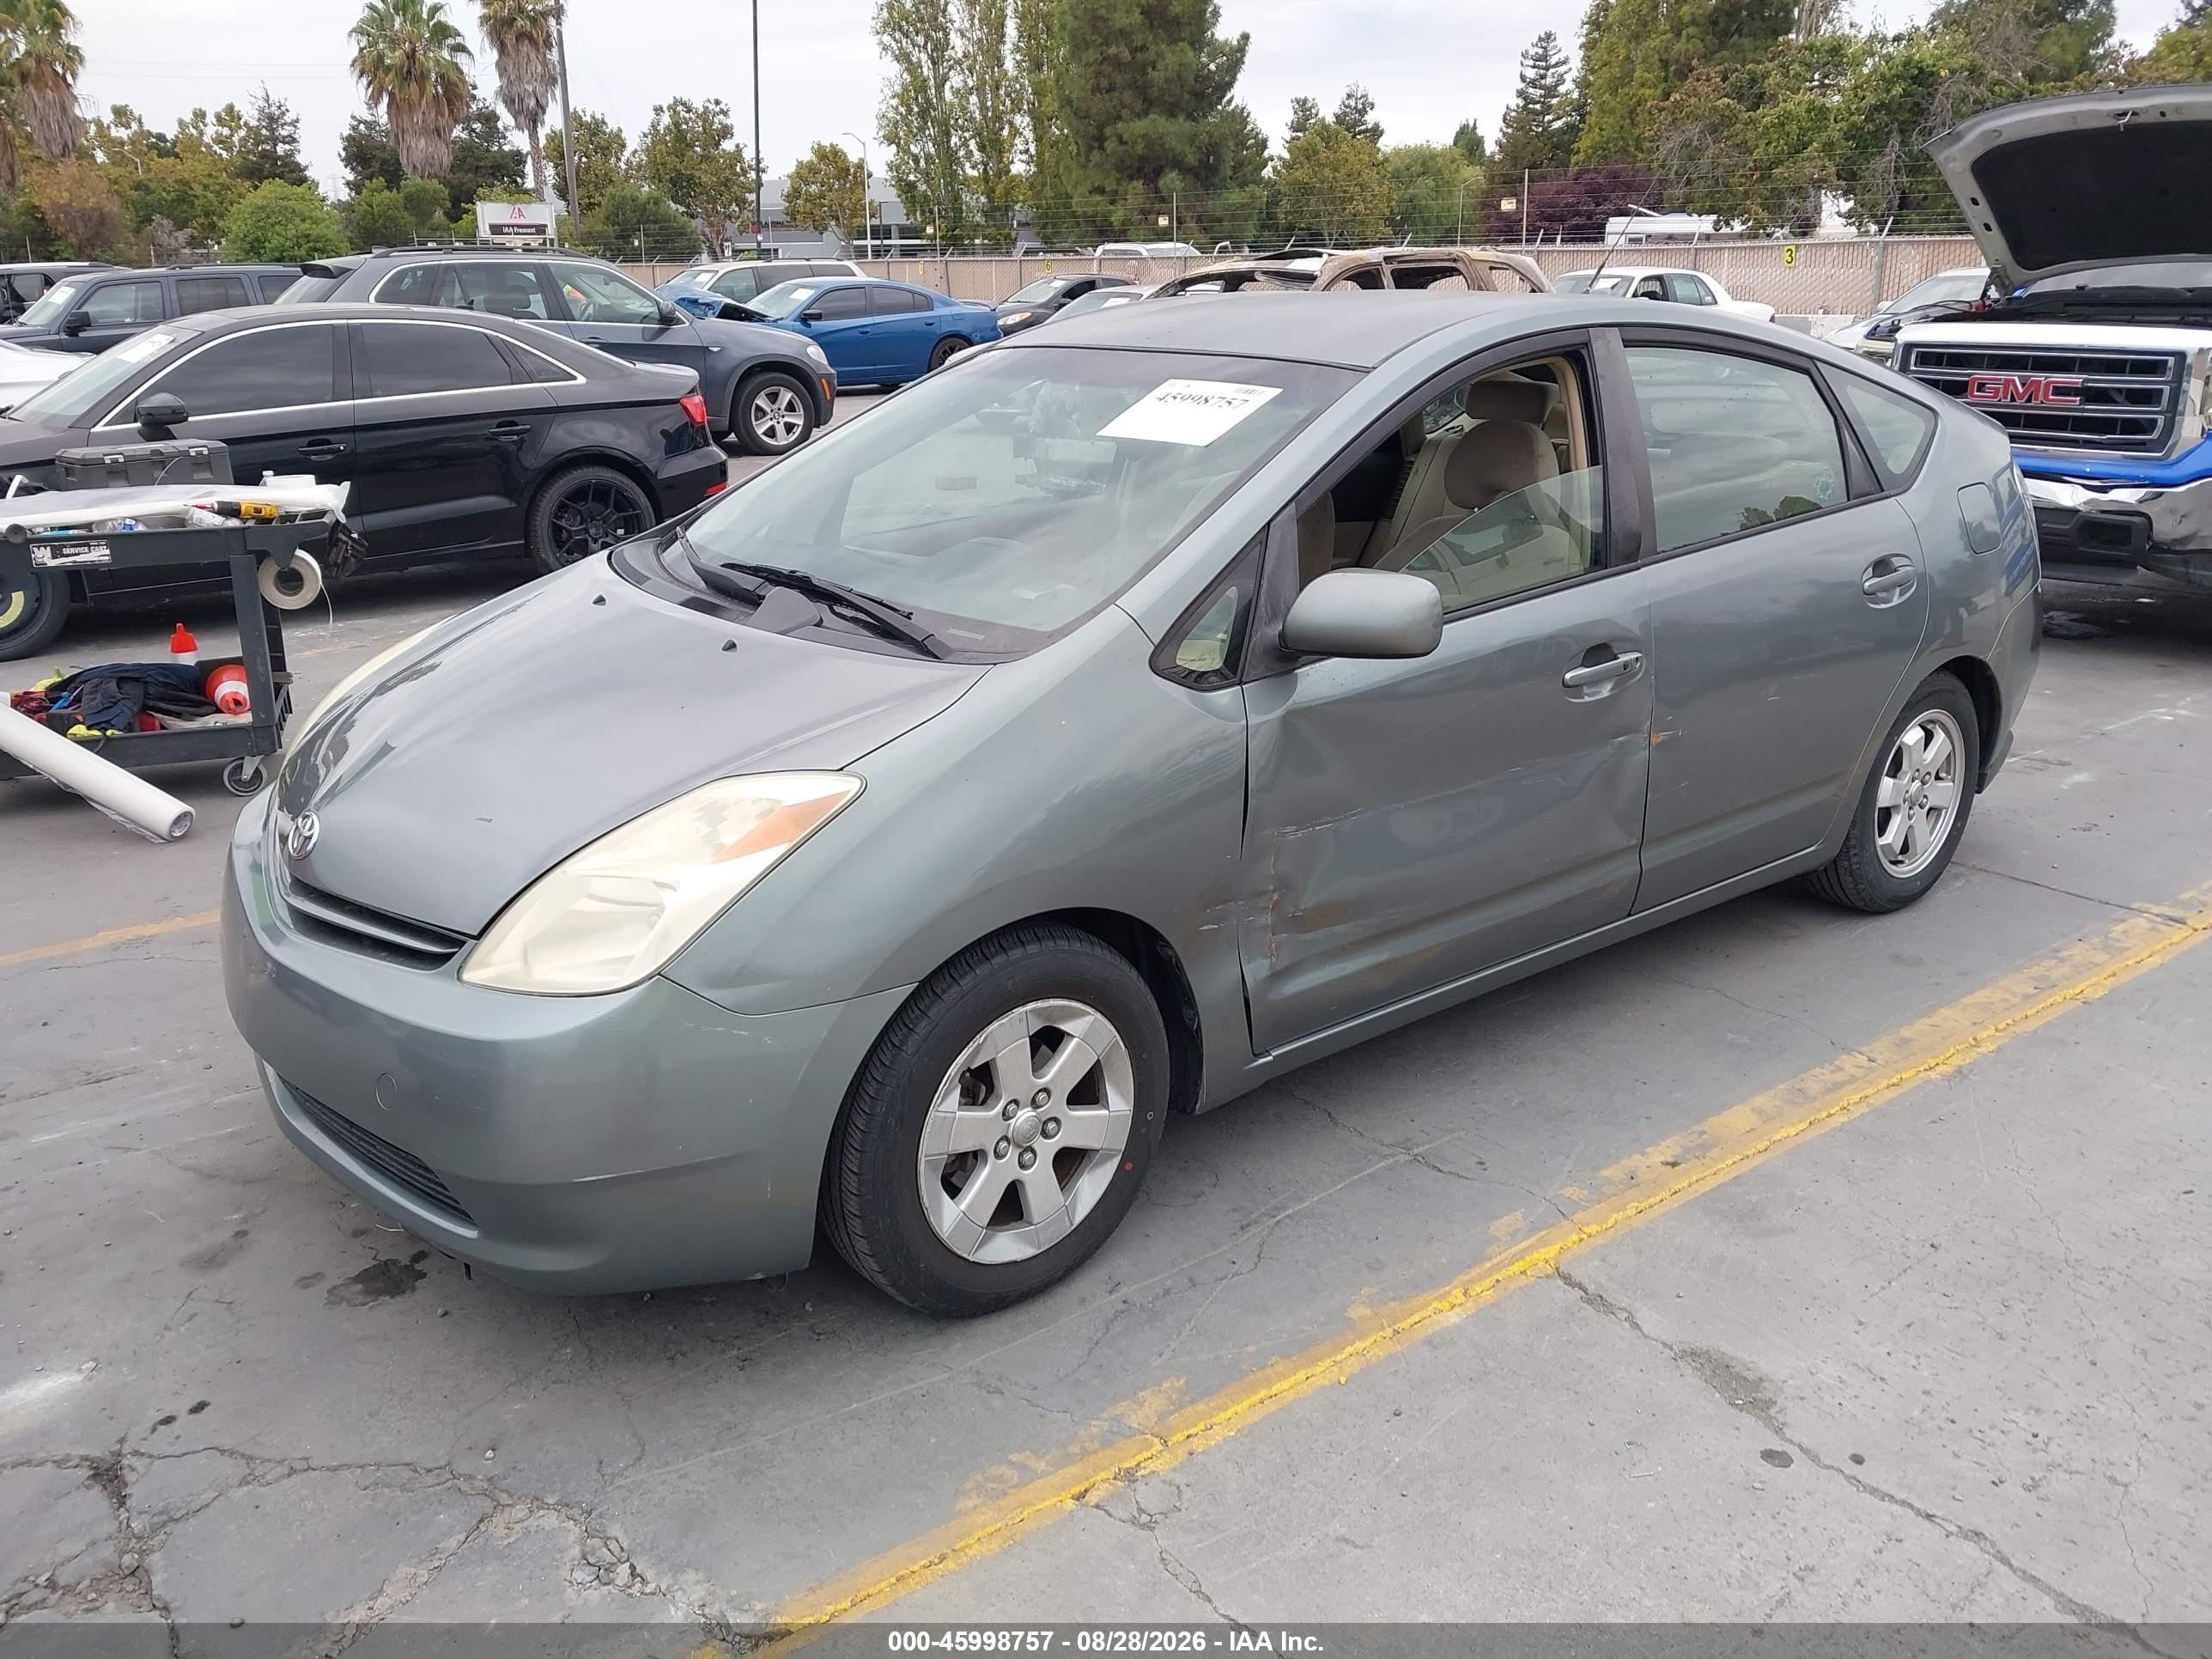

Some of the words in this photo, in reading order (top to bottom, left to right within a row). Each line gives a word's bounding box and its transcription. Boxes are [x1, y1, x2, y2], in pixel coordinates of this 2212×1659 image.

[1785, 248, 1794, 264] 3
[1045, 260, 1051, 271] 6
[1966, 375, 2083, 405] GMC
[1156, 392, 1250, 410] 45998757
[63, 546, 89, 555] SERVICE
